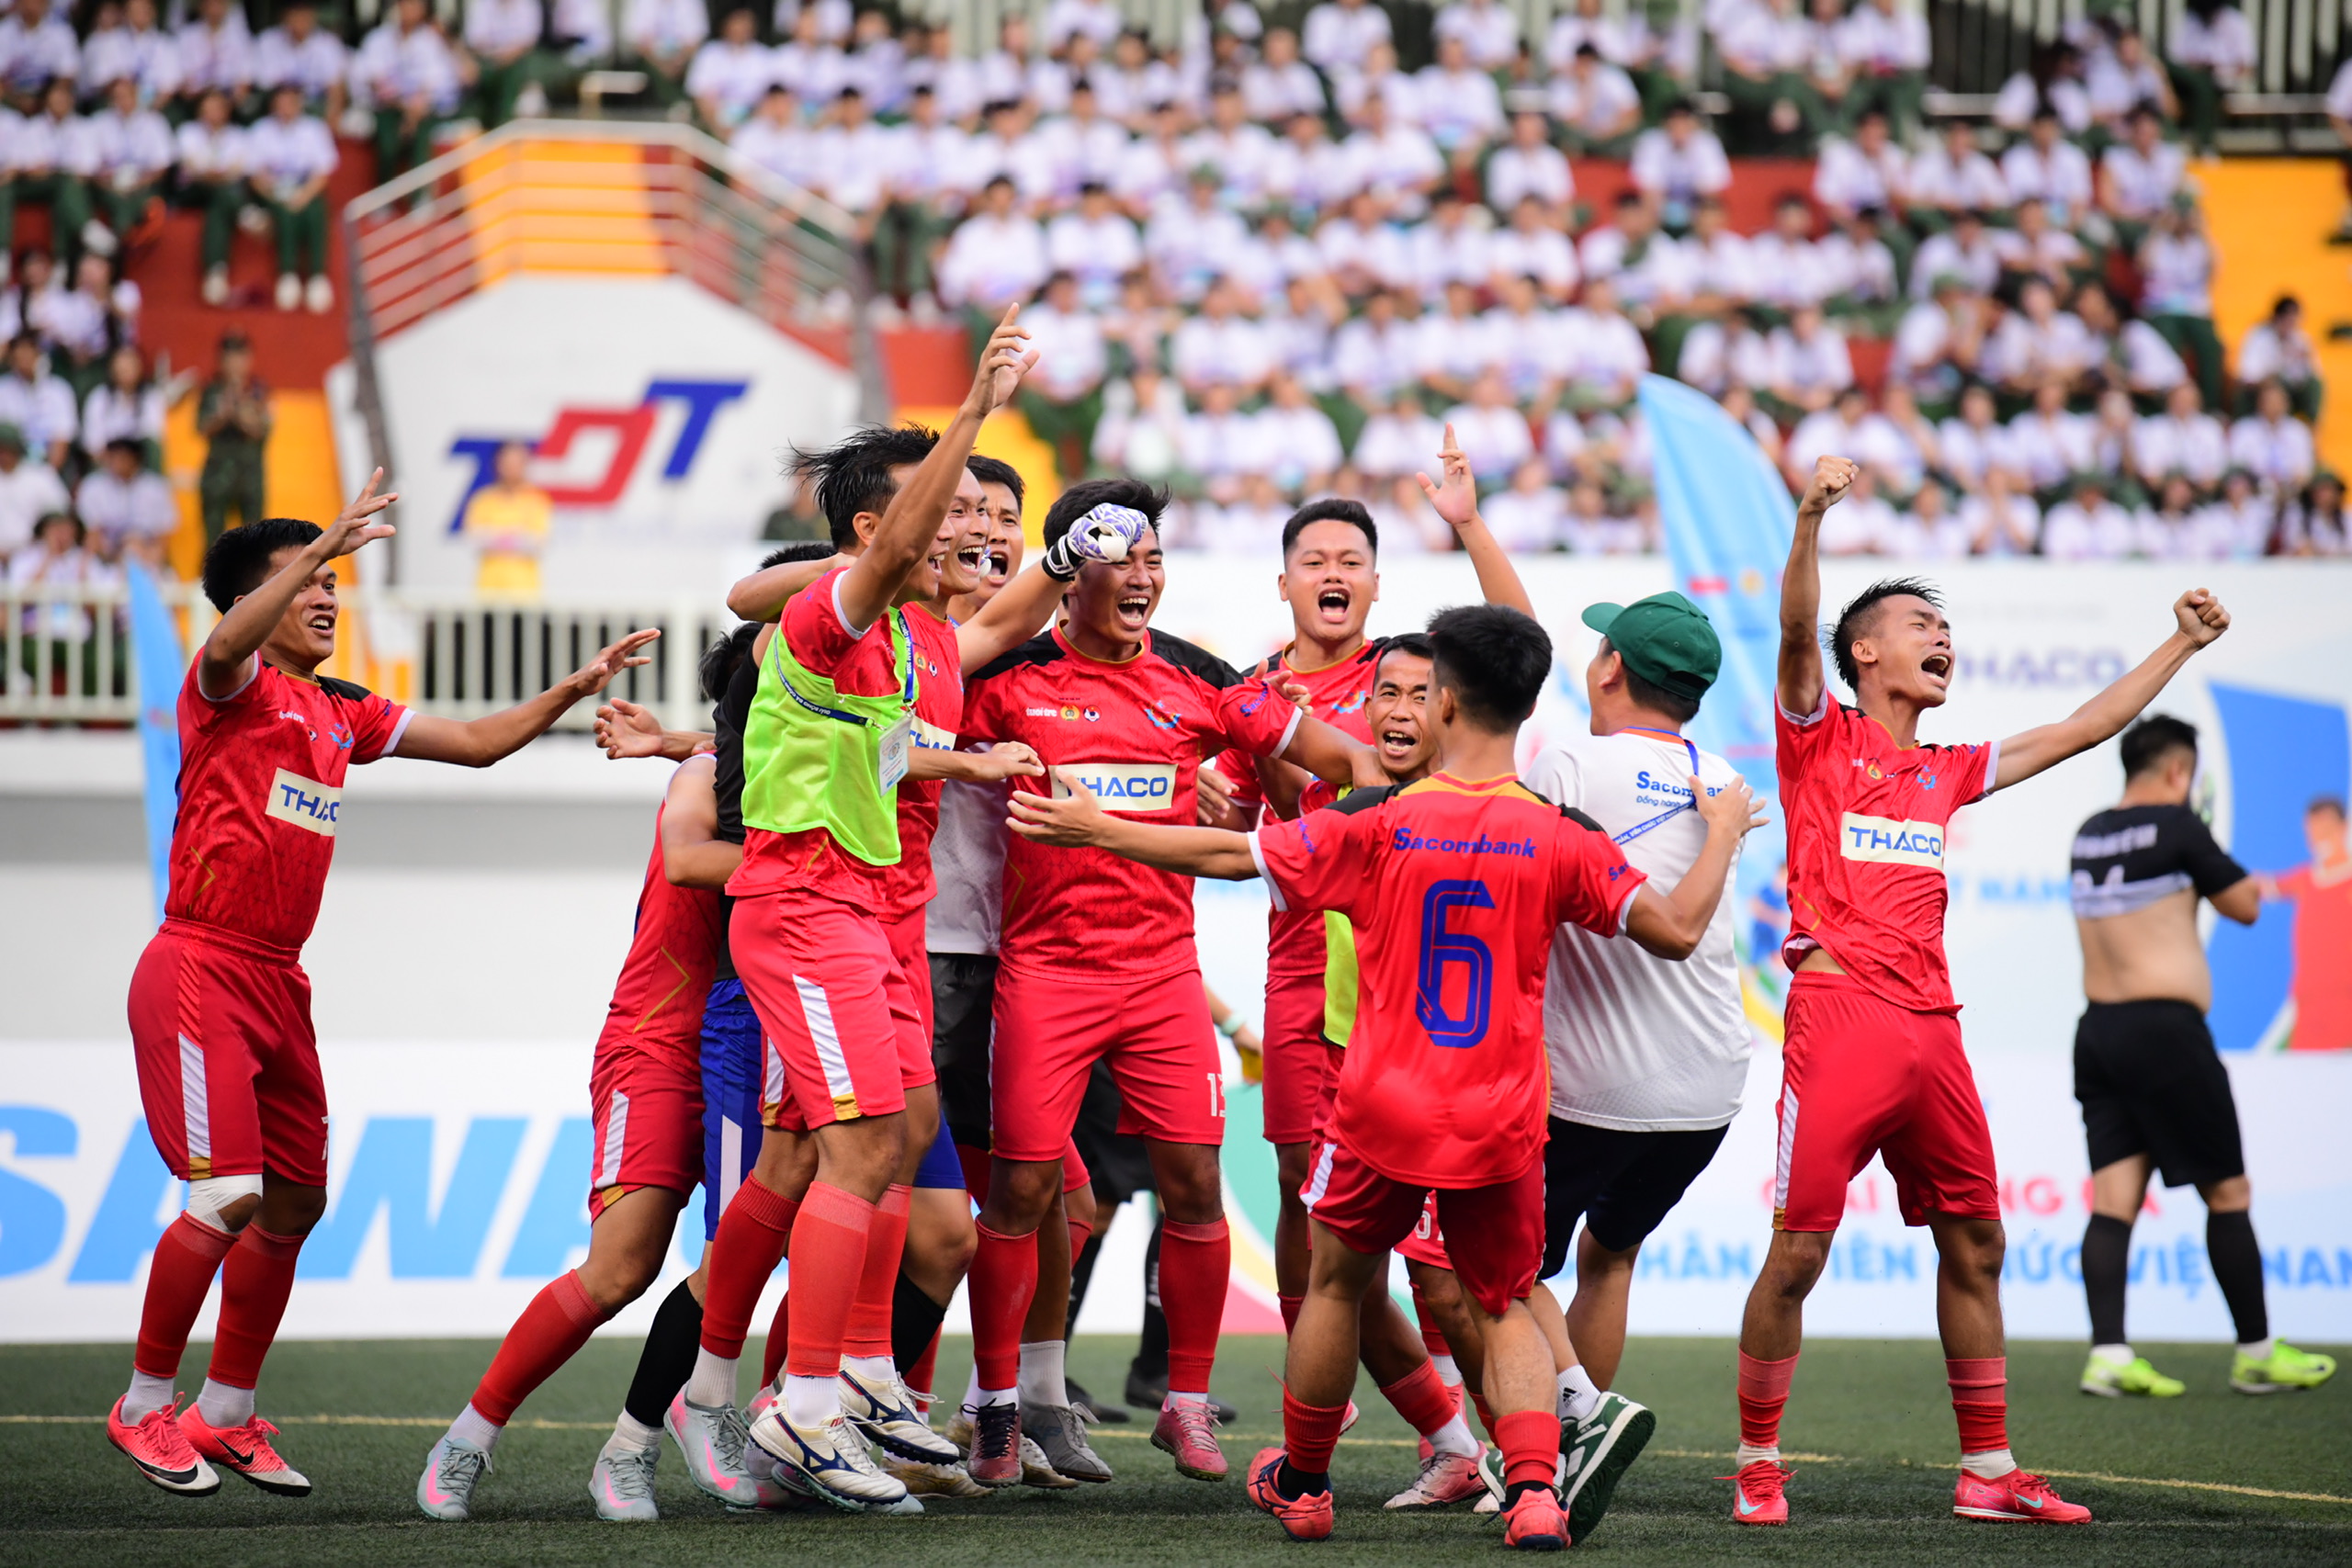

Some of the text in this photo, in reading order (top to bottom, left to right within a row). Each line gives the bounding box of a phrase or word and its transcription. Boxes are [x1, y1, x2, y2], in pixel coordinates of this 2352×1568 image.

[1394, 827, 1538, 859] Sacombank
[1849, 826, 1941, 857] THACO
[1415, 879, 1497, 1049] 6
